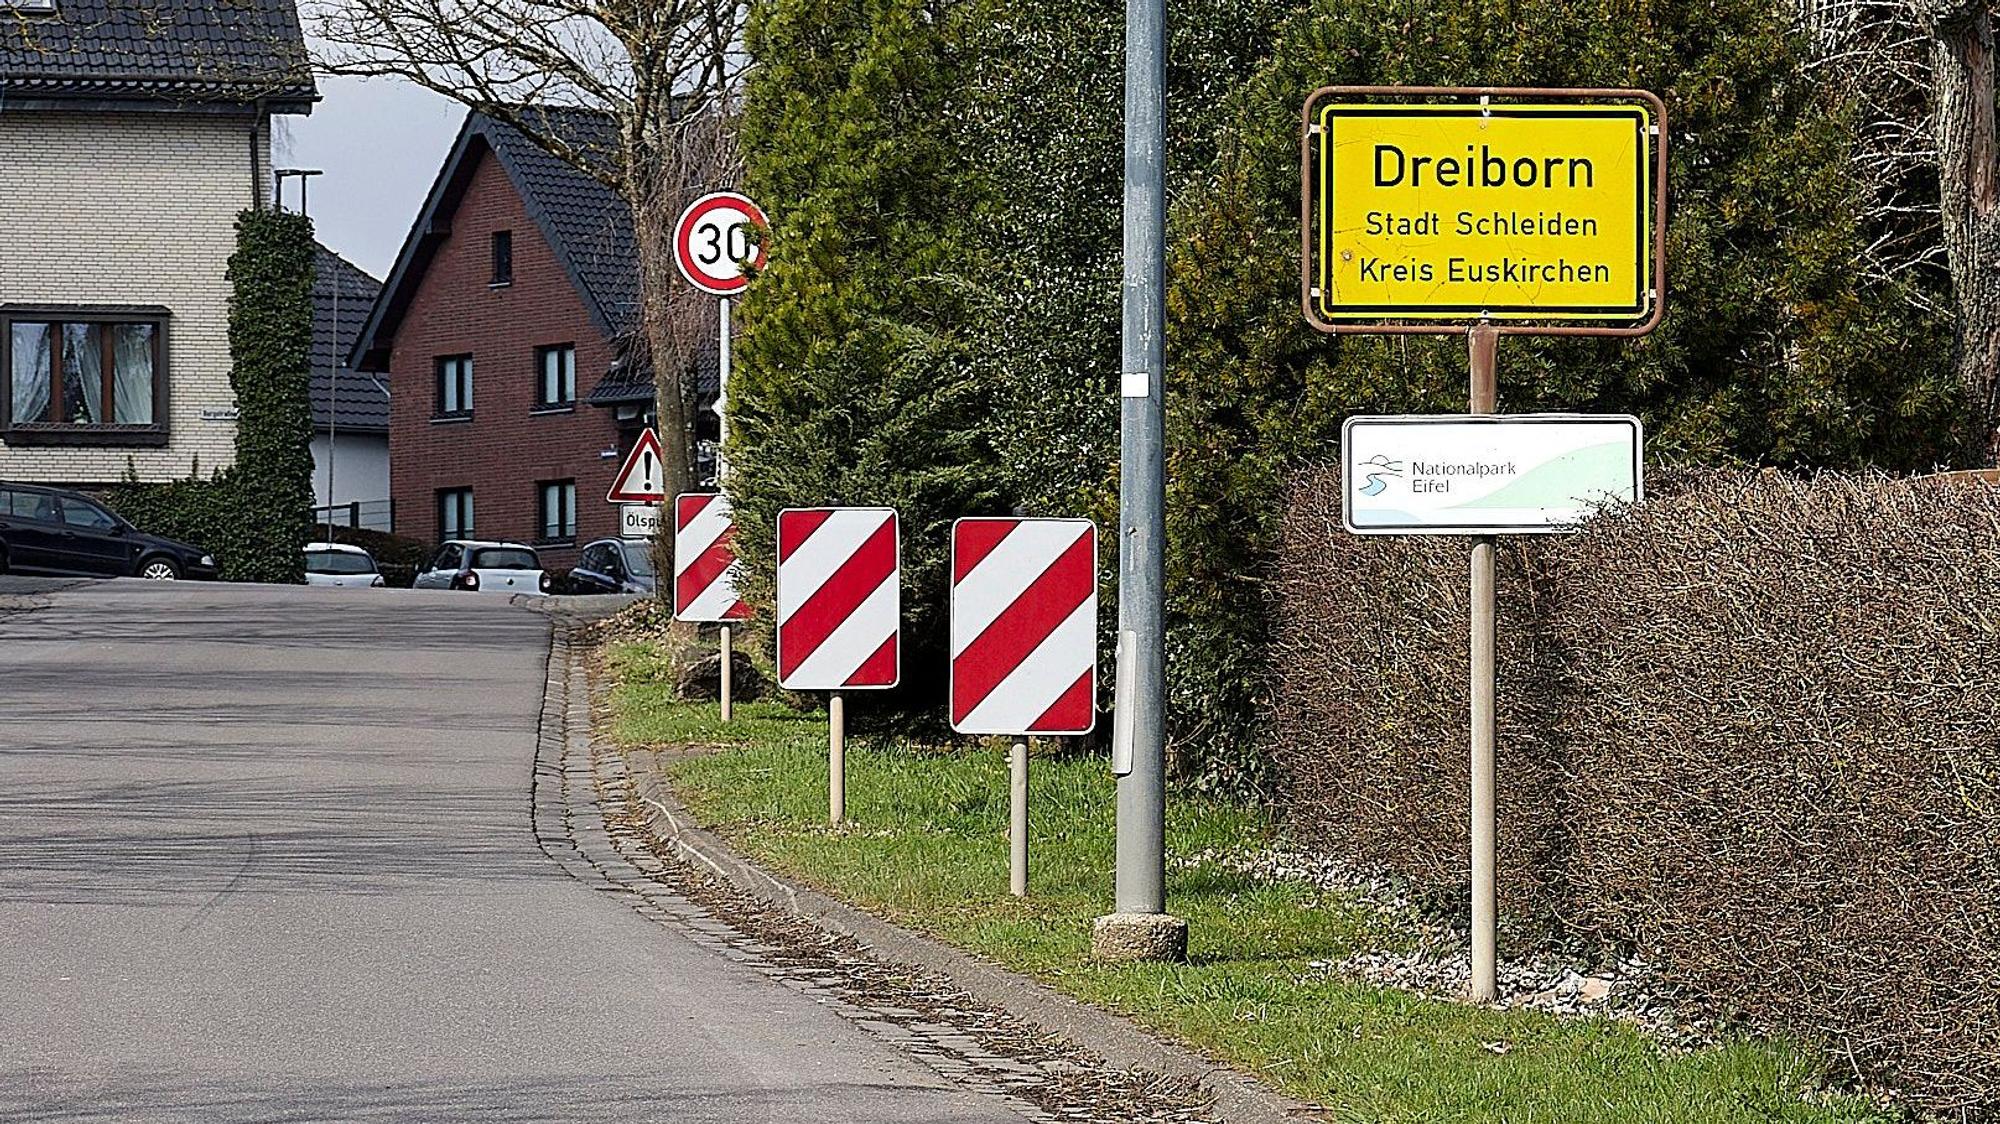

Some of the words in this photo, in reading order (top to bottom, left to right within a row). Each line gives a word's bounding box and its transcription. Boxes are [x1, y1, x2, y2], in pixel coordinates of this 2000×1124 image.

[1375, 144, 1593, 188] Dreiborn
[1366, 212, 1439, 236] Stadt
[1456, 212, 1597, 236] Schleiden
[698, 223, 750, 264] 30
[1360, 257, 1433, 282] Kreis
[1448, 257, 1610, 283] Euskirchen
[1412, 461, 1517, 478] Nationalpark
[1412, 479, 1449, 493] Eifel
